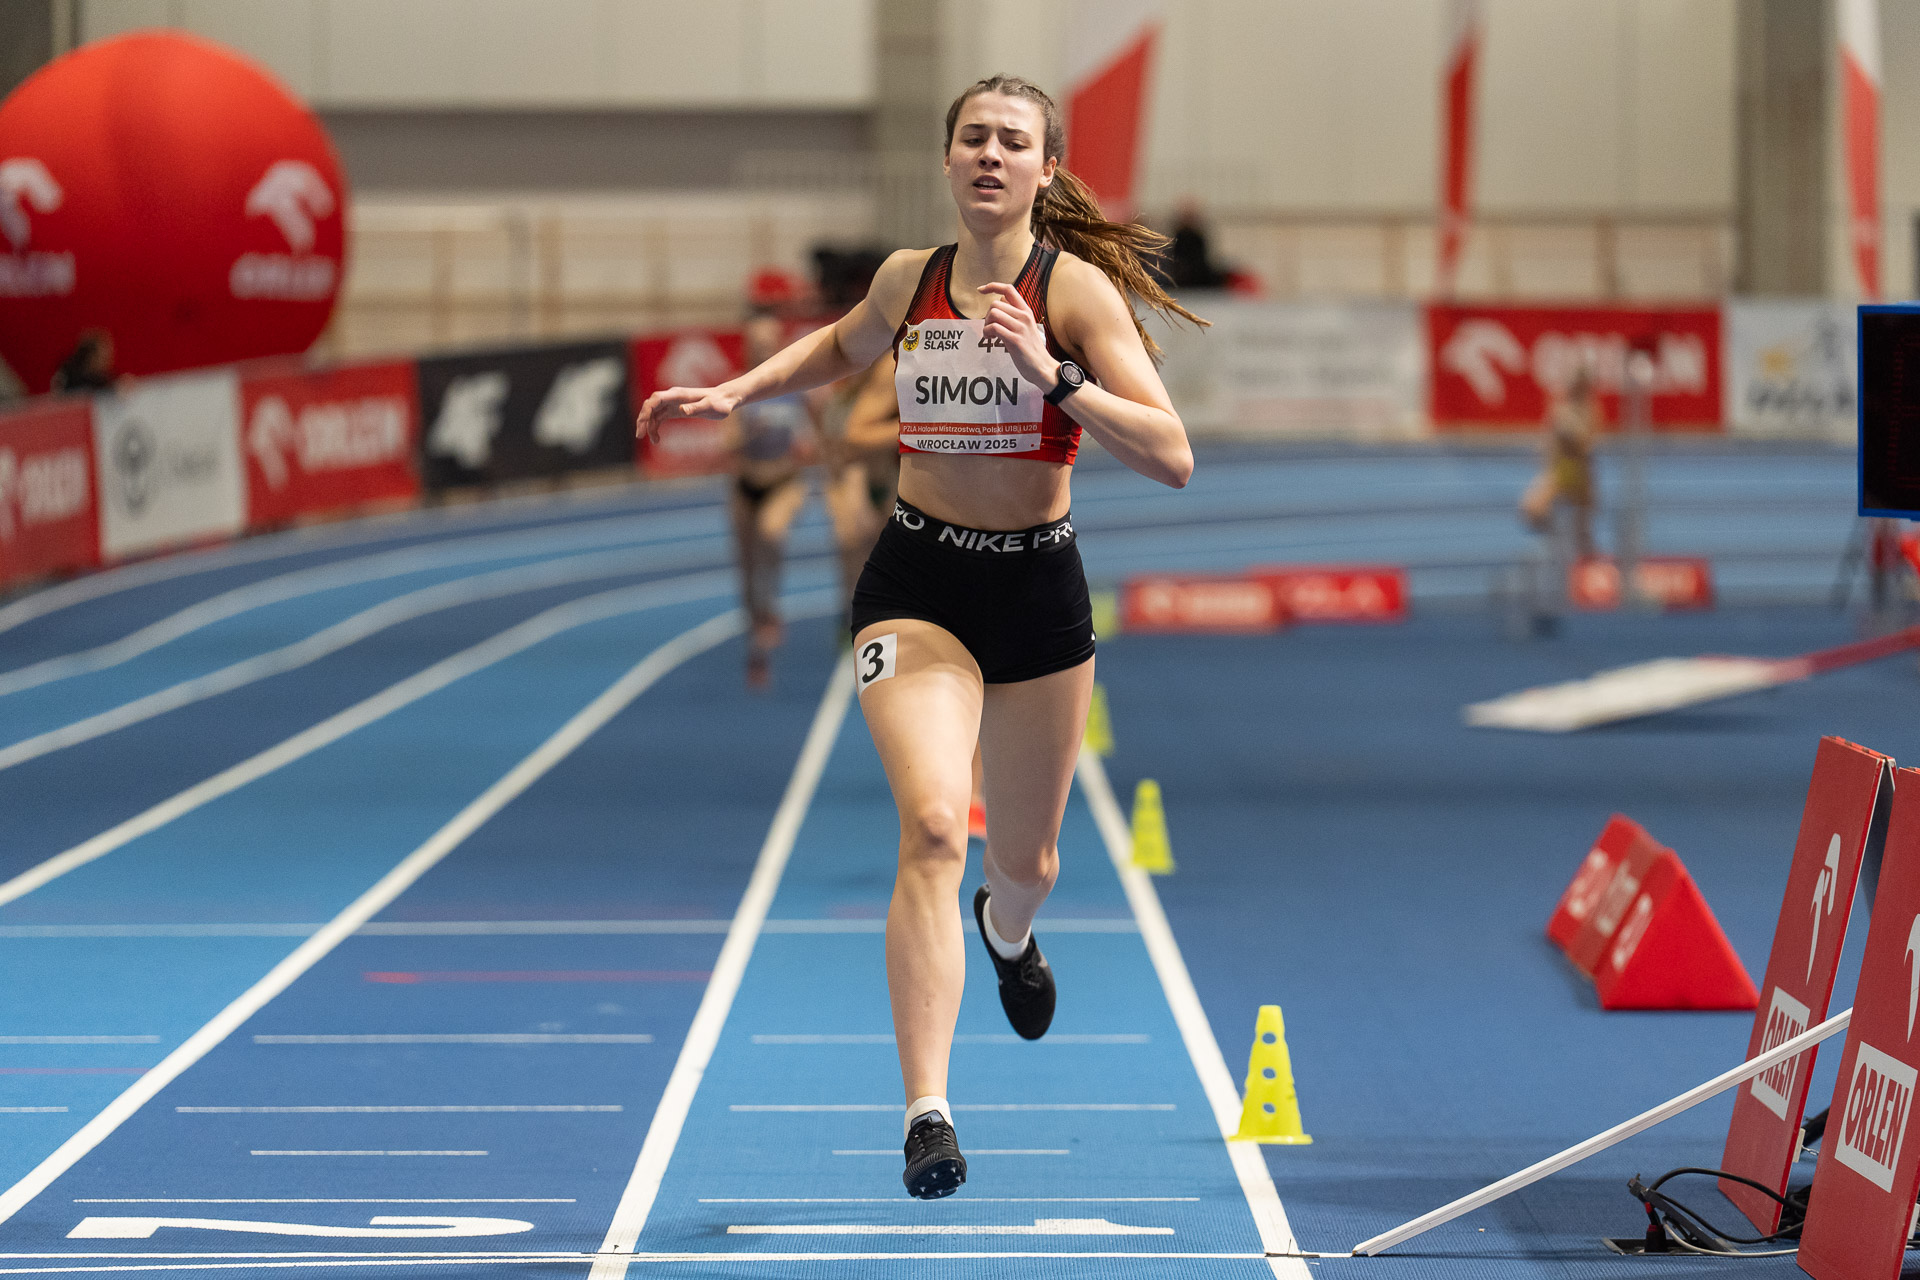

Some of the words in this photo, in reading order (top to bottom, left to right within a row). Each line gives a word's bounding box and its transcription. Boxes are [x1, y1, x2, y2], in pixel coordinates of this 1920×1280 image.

[923, 339, 960, 352] ŚLĄSK
[925, 330, 964, 340] DOLNY
[915, 375, 1019, 406] SIMON
[903, 425, 917, 433] PZLA
[917, 425, 938, 433] Halowe
[982, 425, 1004, 433] Polski
[1023, 424, 1038, 432] U20
[917, 439, 981, 450] WROCŁAW
[984, 438, 1017, 450] 2025
[893, 502, 925, 530] RO
[938, 526, 1026, 552] NIKE
[862, 641, 885, 684] 3
[1844, 1061, 1910, 1171] ORLEN
[65, 1216, 535, 1238] 2
